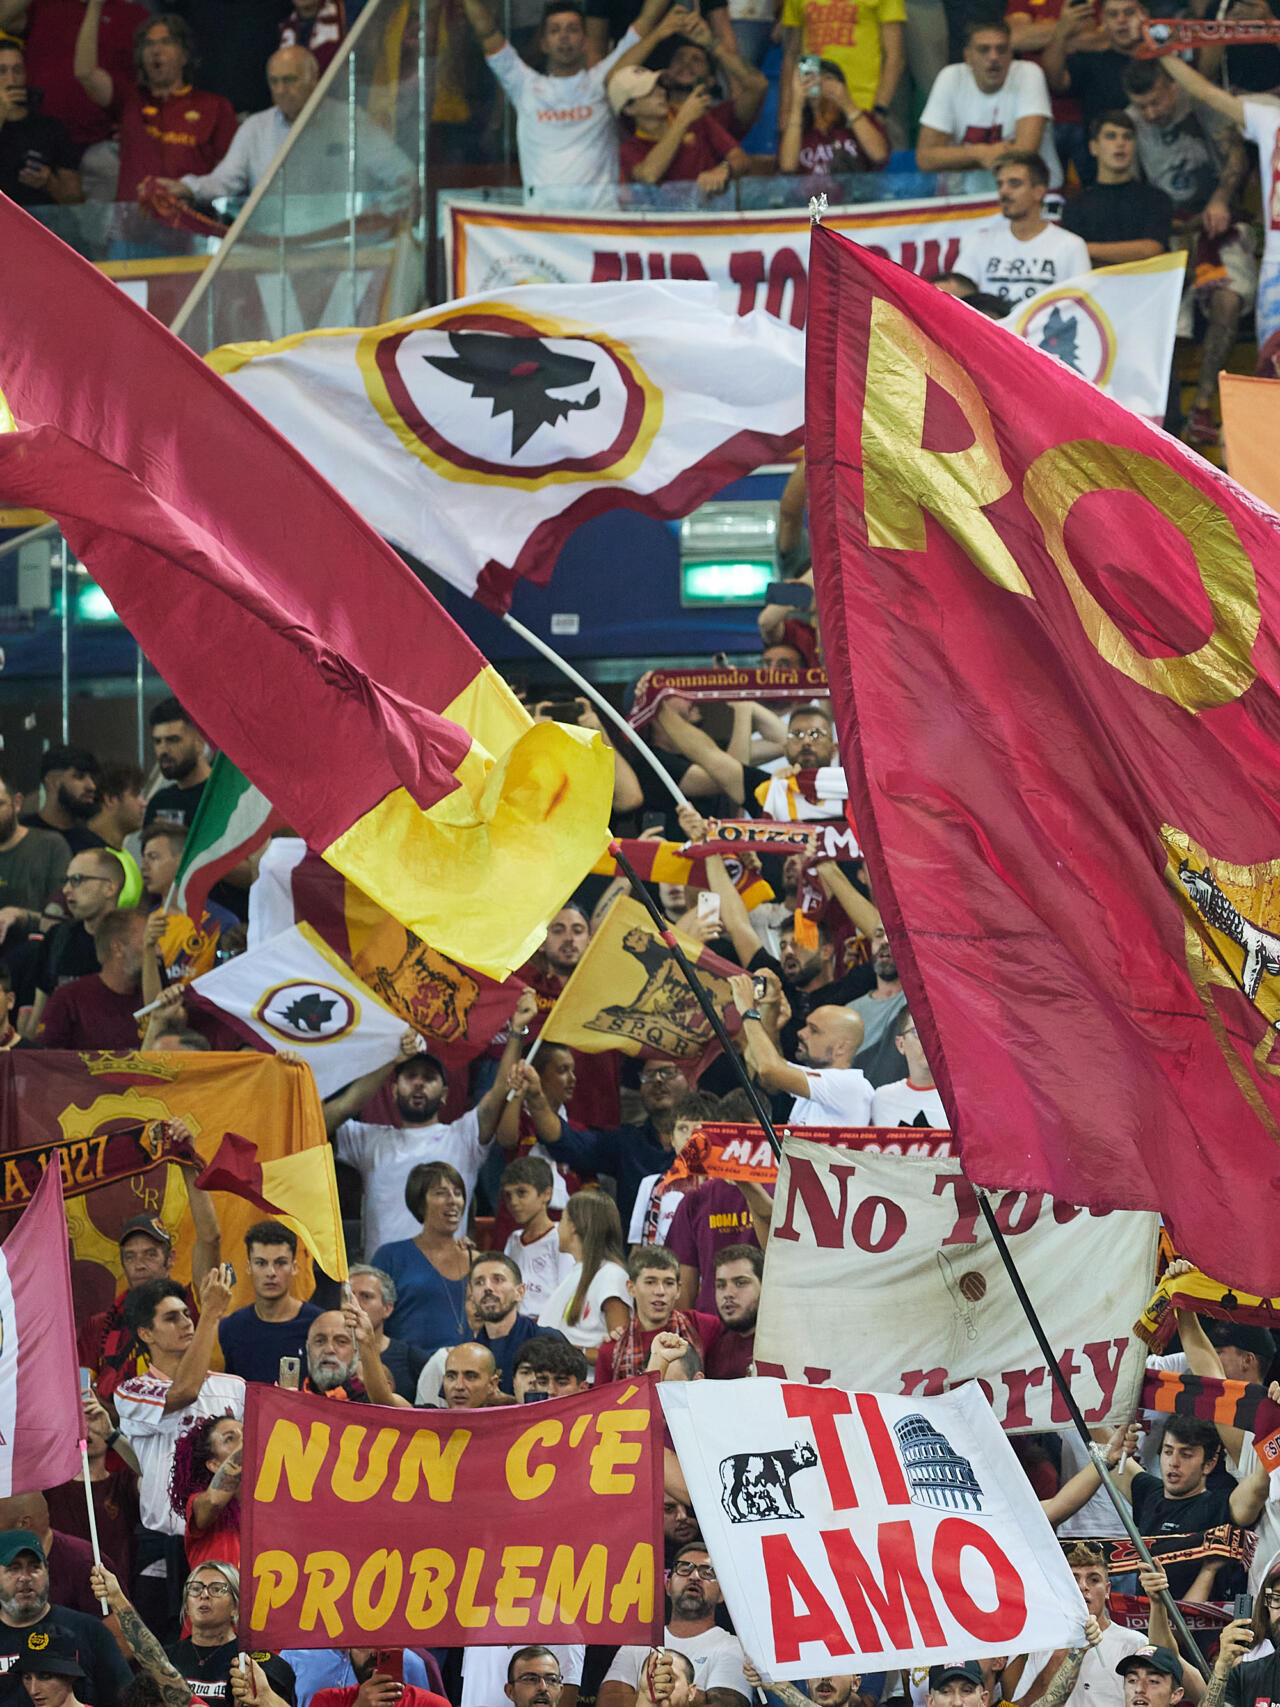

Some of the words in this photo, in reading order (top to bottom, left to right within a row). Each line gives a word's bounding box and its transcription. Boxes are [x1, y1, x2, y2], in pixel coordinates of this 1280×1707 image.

[652, 669, 749, 690] Commando
[714, 822, 811, 847] orza
[773, 1155, 908, 1254] No
[253, 1416, 472, 1504] NUN
[781, 1382, 912, 1512] TI
[249, 1541, 655, 1640] PROBLEMA
[761, 1516, 1029, 1665] AMO
